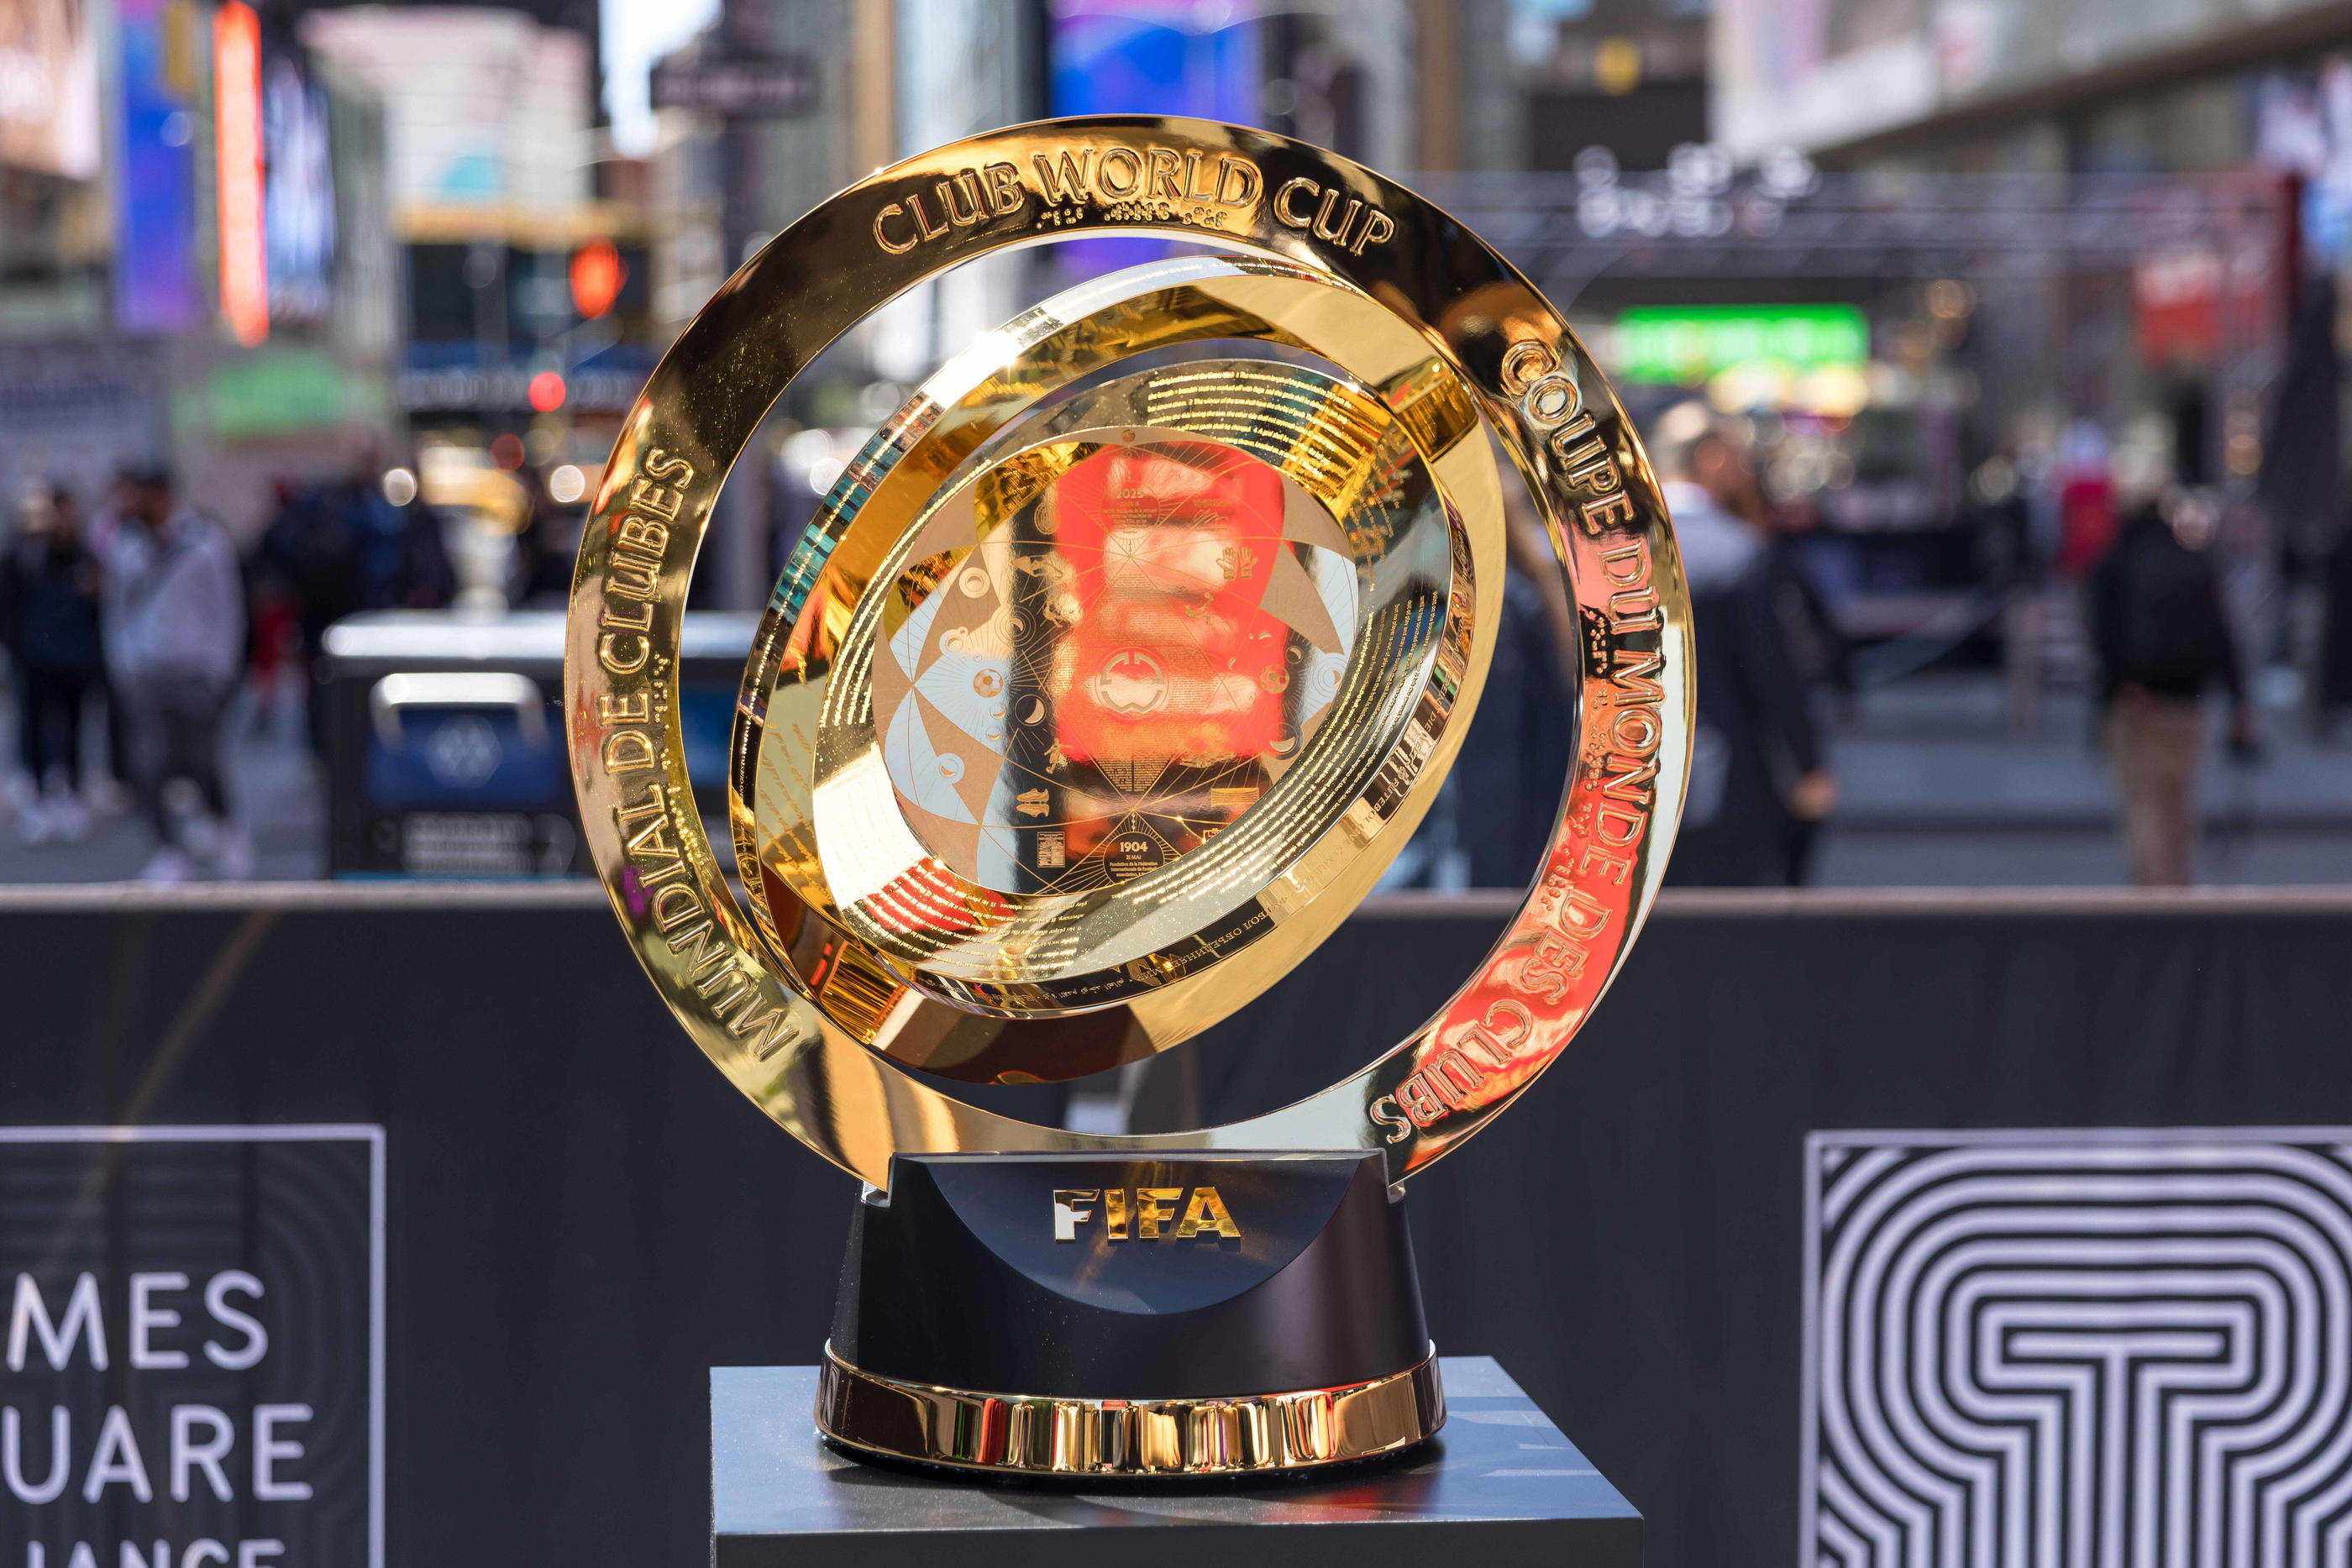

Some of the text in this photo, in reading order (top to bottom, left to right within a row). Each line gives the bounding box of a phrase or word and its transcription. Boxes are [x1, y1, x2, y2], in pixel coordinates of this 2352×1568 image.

[872, 148, 1397, 257] CLUB WORLD CUP
[1116, 488, 1143, 499] 2025
[601, 448, 694, 674] CLUBES
[598, 693, 655, 774] DE
[1369, 340, 1665, 1144] COUPE DU MONDE DES CLUBS
[1423, 711, 1438, 730] DIE
[1362, 777, 1400, 824] FUTEBOL
[1120, 842, 1148, 852] 1904
[617, 783, 800, 1062] MUNDIAL
[1053, 1187, 1242, 1242] FIFA
[7, 1269, 269, 1372] MES
[2, 1403, 314, 1504] UARE
